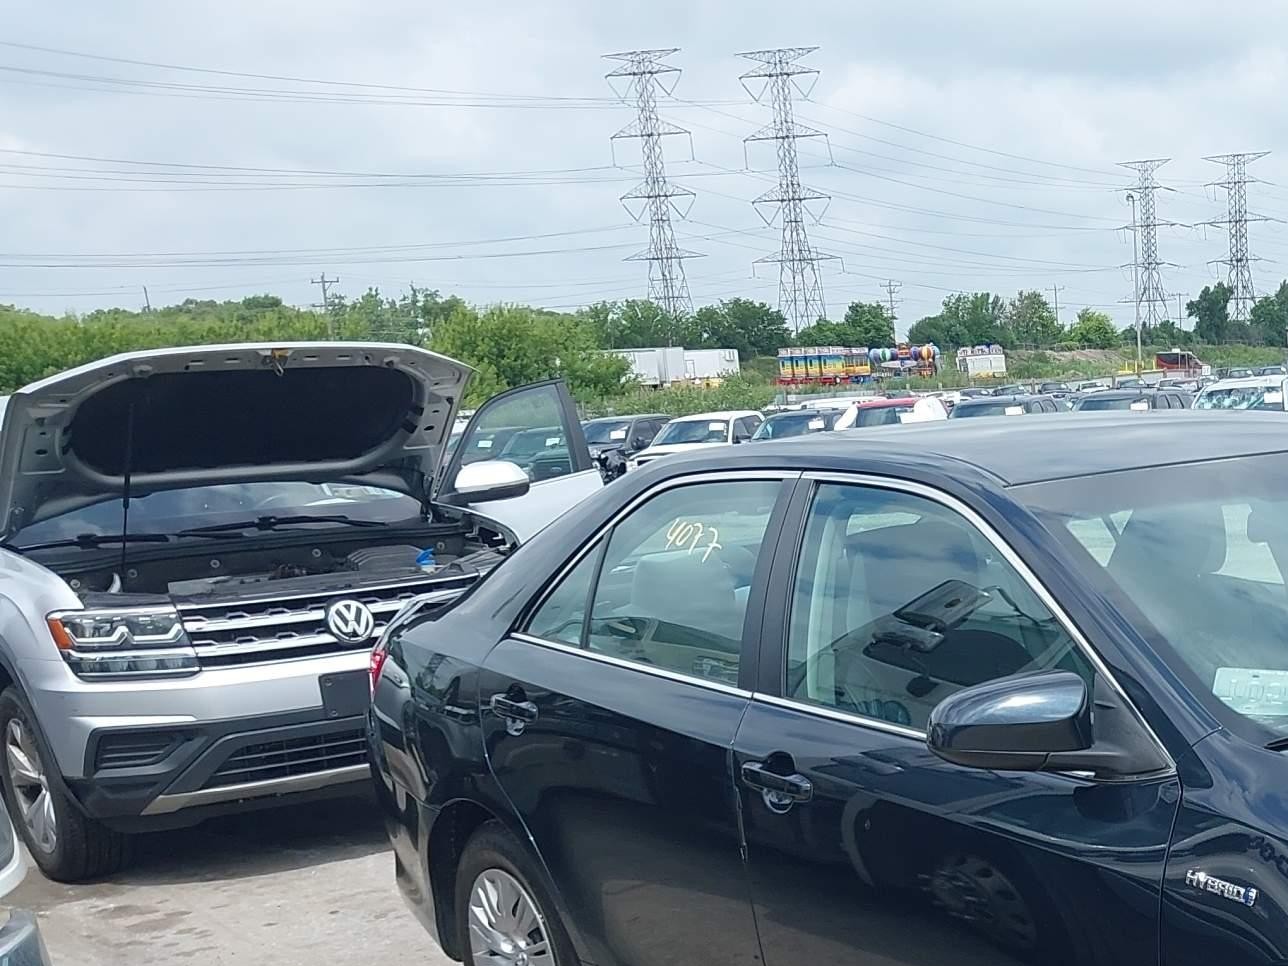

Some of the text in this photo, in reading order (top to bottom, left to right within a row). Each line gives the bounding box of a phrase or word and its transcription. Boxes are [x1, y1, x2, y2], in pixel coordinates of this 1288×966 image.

[664, 516, 722, 563] 4077
[328, 599, 374, 642] VW
[1185, 869, 1246, 904] HYBRID
